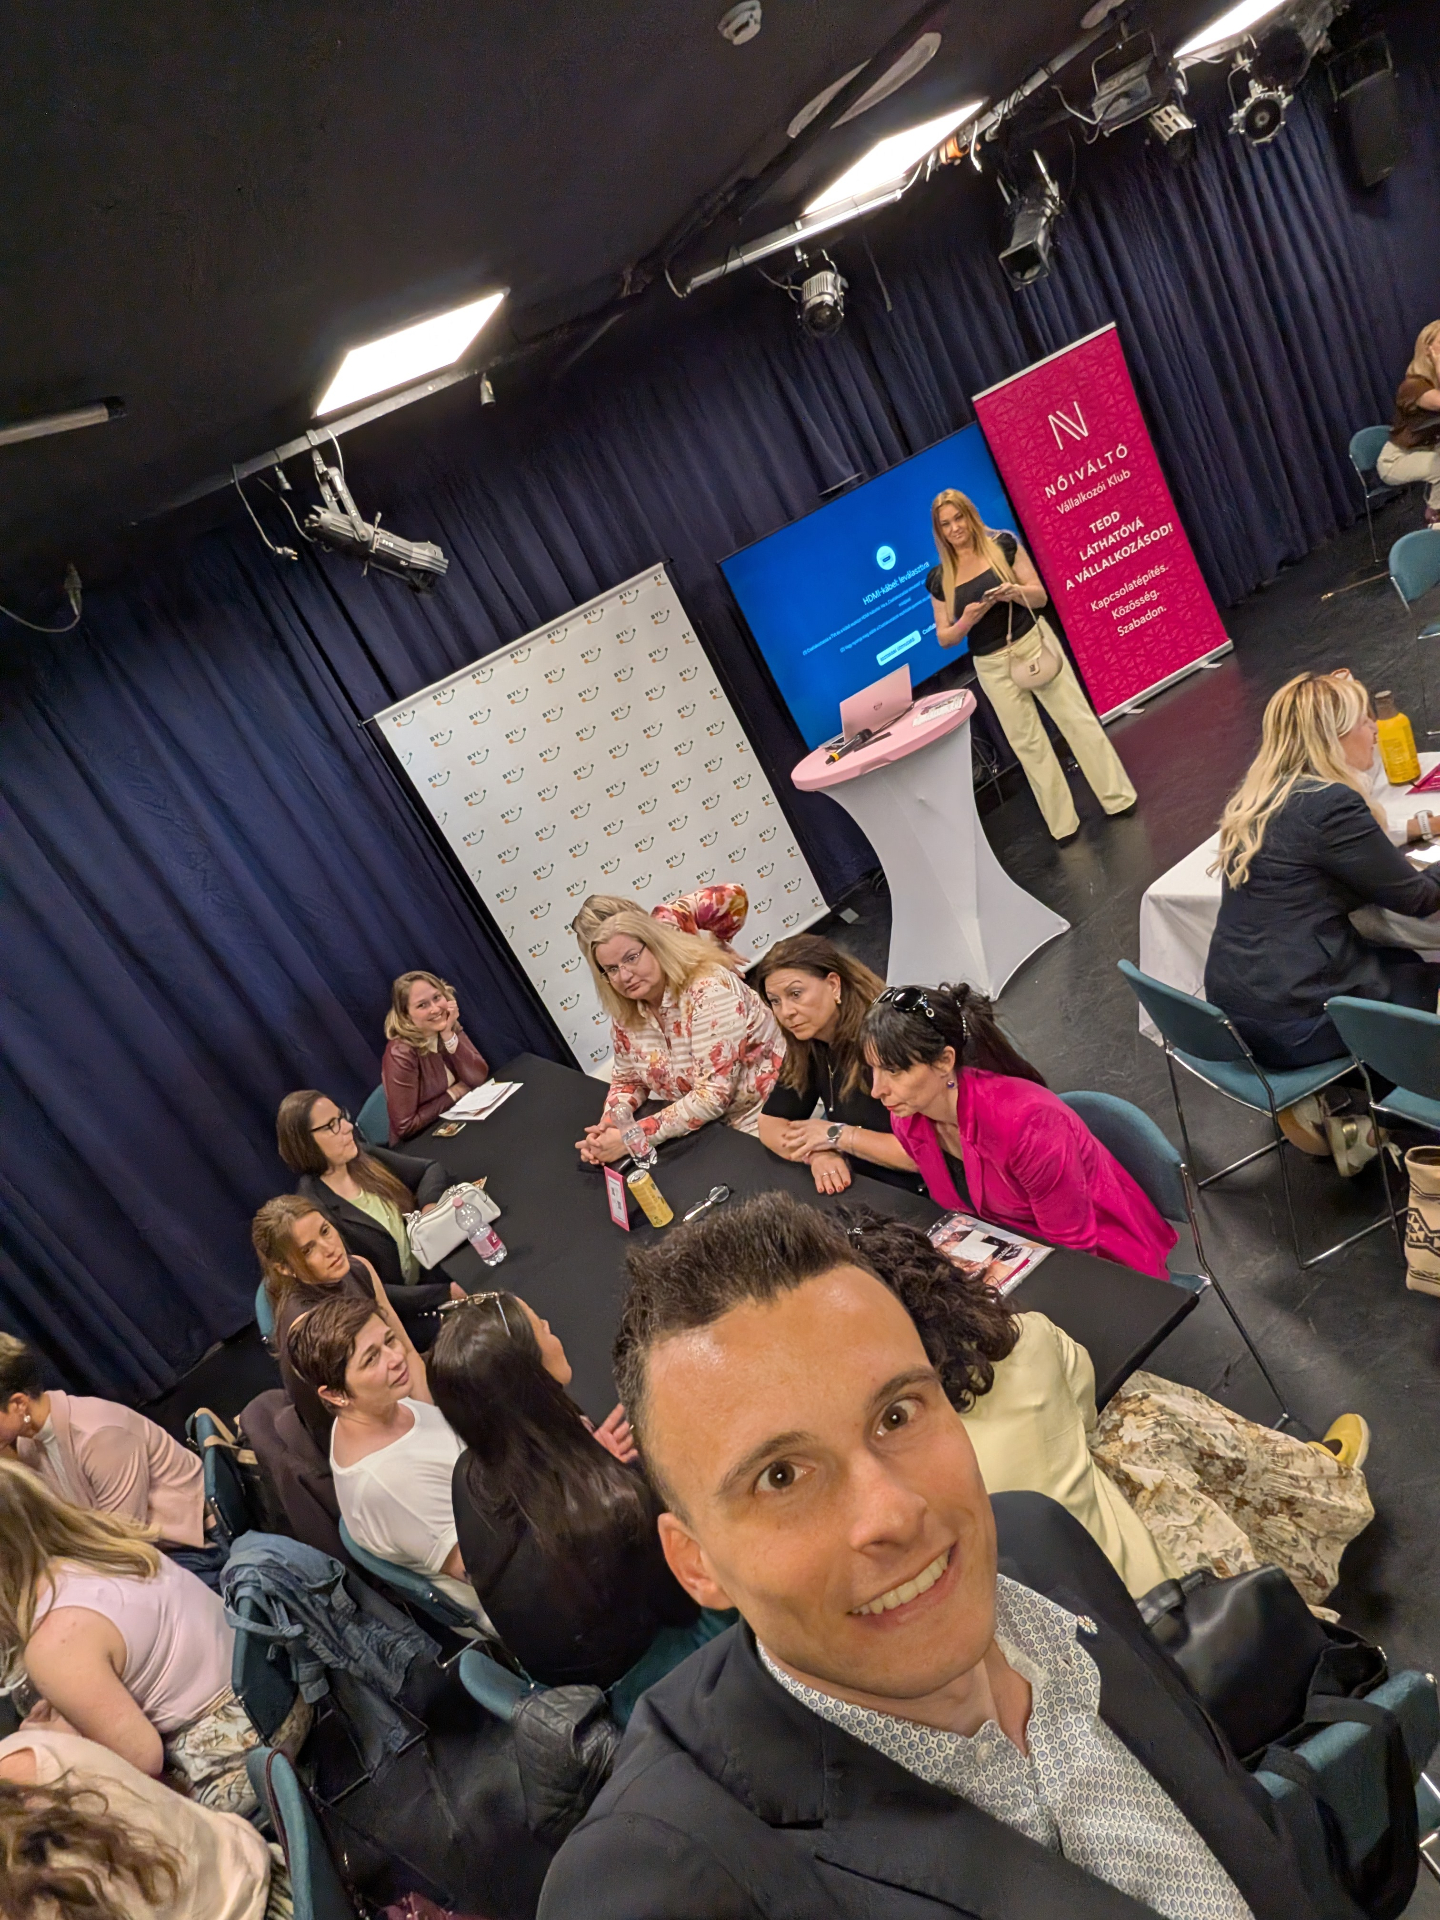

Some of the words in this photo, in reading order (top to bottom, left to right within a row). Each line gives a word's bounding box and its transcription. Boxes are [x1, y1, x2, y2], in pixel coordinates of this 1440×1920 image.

[1044, 443, 1129, 499] NŐIVÁLTÓ
[1056, 483, 1106, 514] Vállalkozói
[1106, 469, 1131, 488] Klub
[1088, 511, 1120, 534] TEDD
[1079, 516, 1145, 561] LÁTHATÓVÁ
[1065, 578, 1076, 591] A
[1074, 522, 1174, 584] VÁLLALKOZÁSOD!
[1090, 564, 1169, 612] Kapcsolatépítés.
[618, 591, 632, 600] BYL
[1111, 589, 1160, 620] Közösség.
[583, 610, 596, 619] BYL
[650, 610, 663, 620] BYL
[1117, 605, 1167, 637] Szabadon.
[546, 630, 560, 639] BYL
[616, 630, 628, 639] BYL
[509, 649, 524, 659] BYL
[580, 649, 594, 659] BYL
[648, 648, 662, 658] BYL
[471, 670, 486, 680] BYL
[544, 669, 558, 679] BYL
[614, 668, 626, 678] BYL
[679, 668, 691, 677] BYL
[432, 691, 447, 701] BYL
[506, 690, 521, 700] BYL
[578, 688, 592, 698] BYL
[645, 687, 658, 696] BYL
[542, 708, 556, 718] BYL
[610, 707, 624, 716] BYL
[677, 705, 690, 714] BYL
[392, 712, 407, 723] BYL
[468, 710, 484, 720] BYL
[575, 727, 588, 737] BYL
[642, 724, 656, 734] BYL
[706, 722, 718, 732] BYL
[429, 732, 444, 742] BYL
[505, 729, 519, 739] BYL
[608, 745, 622, 754] BYL
[674, 742, 686, 752] BYL
[467, 751, 482, 761] BYL
[538, 748, 552, 758] BYL
[640, 762, 652, 772] BYL
[704, 759, 717, 768] BYL
[502, 769, 516, 780] BYL
[573, 766, 587, 776] BYL
[428, 773, 443, 784] BYL
[732, 776, 745, 785] BYL
[605, 784, 619, 794] BYL
[671, 779, 684, 789] BYL
[464, 791, 479, 802] BYL
[537, 787, 550, 797] BYL
[637, 800, 650, 810] BYL
[702, 796, 714, 806] BYL
[500, 809, 514, 819] BYL
[570, 805, 584, 815] BYL
[668, 817, 681, 827] BYL
[730, 812, 742, 822] BYL
[534, 826, 548, 837] BYL
[603, 822, 616, 832] BYL
[462, 832, 477, 842] BYL
[699, 833, 712, 843] BYL
[758, 829, 770, 838] BYL
[634, 838, 648, 848] BYL
[568, 843, 582, 854] BYL
[497, 849, 512, 859] BYL
[666, 854, 678, 864] BYL
[728, 850, 740, 859] BYL
[600, 860, 613, 870] BYL
[757, 864, 769, 874] BYL
[532, 866, 546, 876] BYL
[696, 870, 709, 880] BYL
[632, 876, 645, 886] BYL
[784, 880, 796, 889] BYL
[566, 882, 580, 892] BYL
[496, 888, 510, 899] BYL
[662, 892, 675, 902] BYL
[530, 905, 544, 915] BYL
[754, 900, 766, 910] BYL
[782, 915, 794, 924] BYL
[751, 935, 763, 945] BYL
[528, 943, 542, 954] BYL
[561, 959, 574, 969] BYL
[559, 996, 572, 1006] BYL
[590, 1048, 603, 1059] BYL
